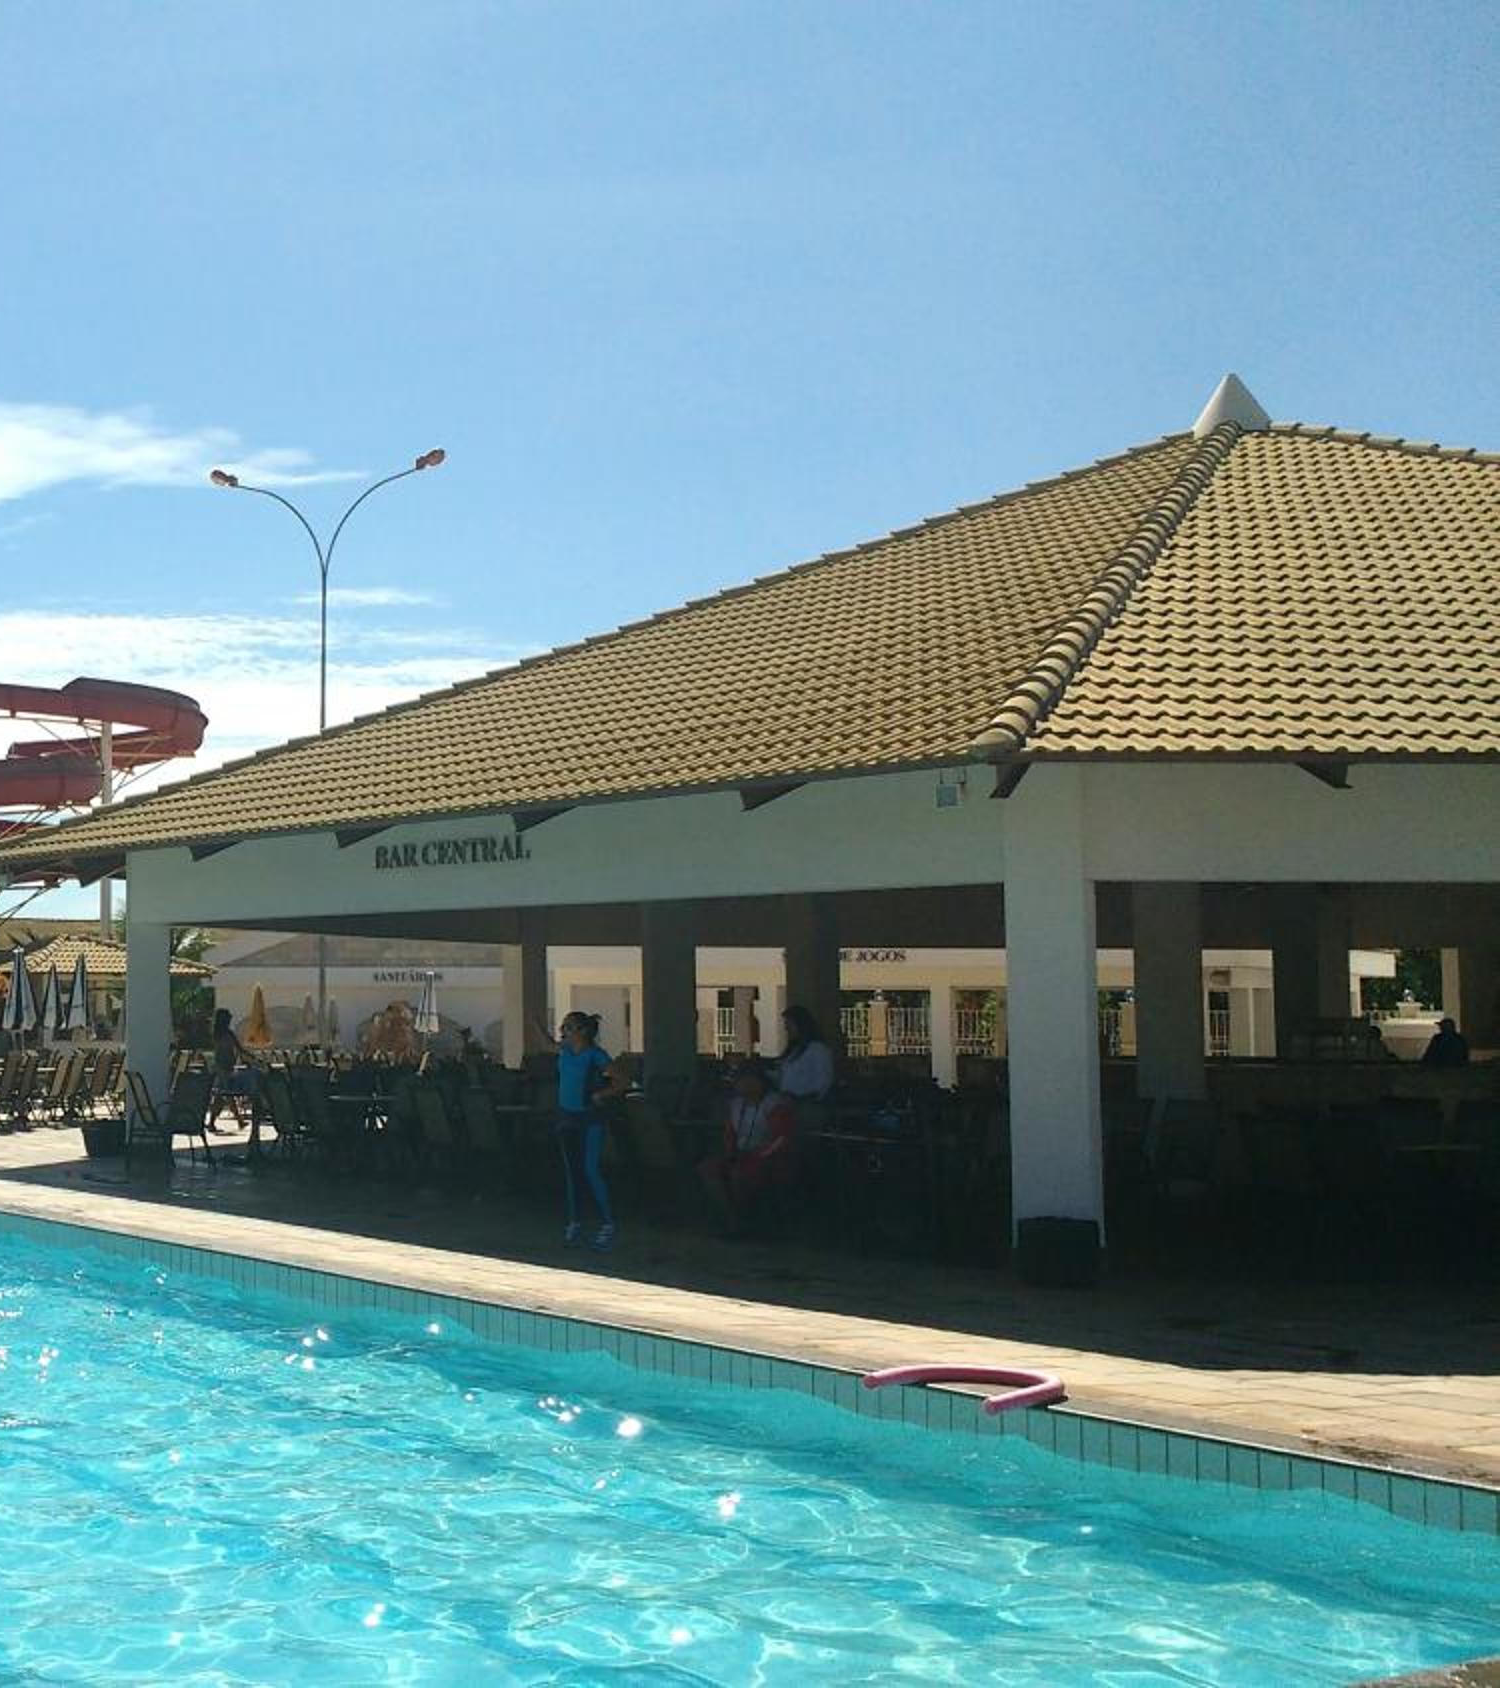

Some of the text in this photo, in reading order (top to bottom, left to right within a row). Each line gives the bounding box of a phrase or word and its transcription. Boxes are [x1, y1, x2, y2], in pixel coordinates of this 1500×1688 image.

[375, 834, 531, 869] BAR CENTRAL
[855, 950, 906, 961] JOGOS
[373, 967, 443, 983] SANITÁRIS
